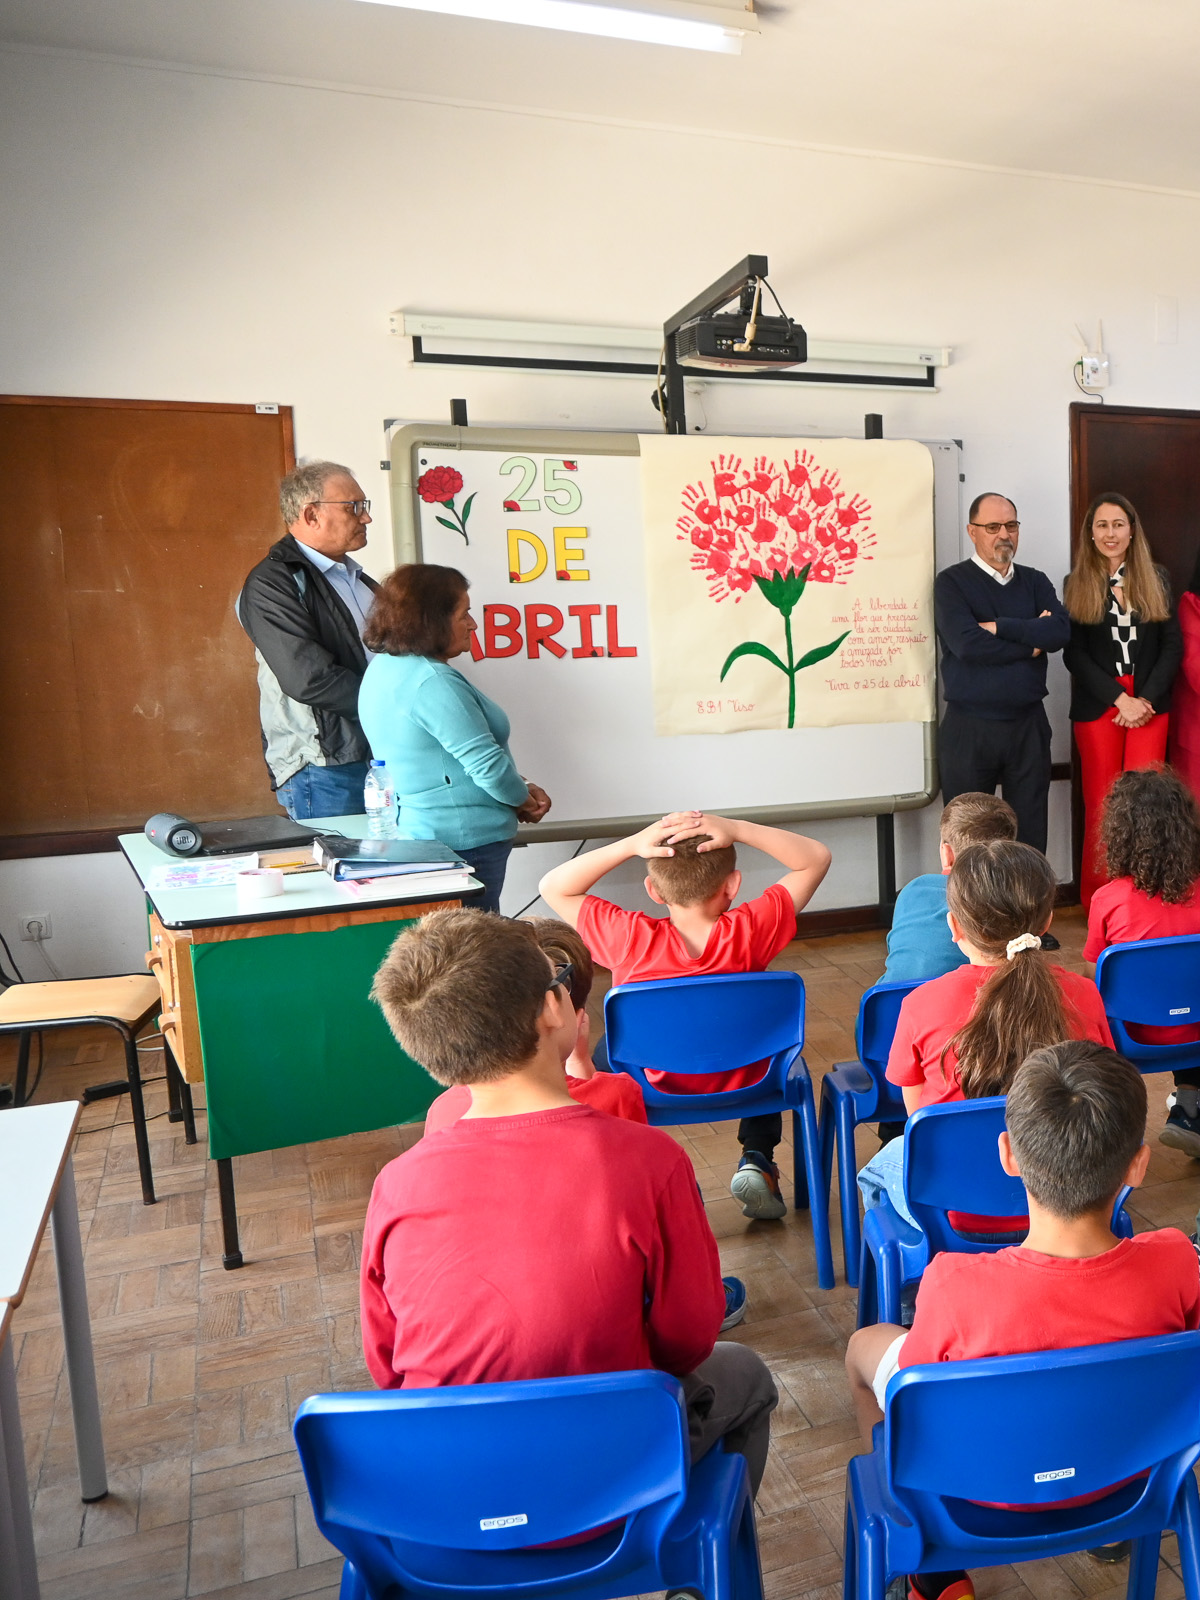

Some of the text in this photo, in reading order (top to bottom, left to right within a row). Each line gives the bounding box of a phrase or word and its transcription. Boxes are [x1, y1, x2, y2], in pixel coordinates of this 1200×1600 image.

[499, 456, 582, 515] 25
[507, 527, 590, 583] DE
[852, 597, 919, 610] A liberdade é
[853, 611, 868, 629] flor
[870, 615, 883, 627] que
[887, 614, 919, 627] precisa
[856, 624, 865, 633] de
[847, 636, 865, 645] com
[847, 645, 883, 662] amizade
[887, 646, 903, 657] por
[840, 658, 865, 668] todos
[825, 678, 850, 690] Viva
[853, 681, 861, 690] o
[862, 678, 877, 689] 25
[877, 677, 890, 688] de
[727, 699, 756, 712] Viso
[176, 835, 192, 845] JBL
[1037, 1469, 1072, 1480] ergos
[483, 1516, 524, 1527] ergos
